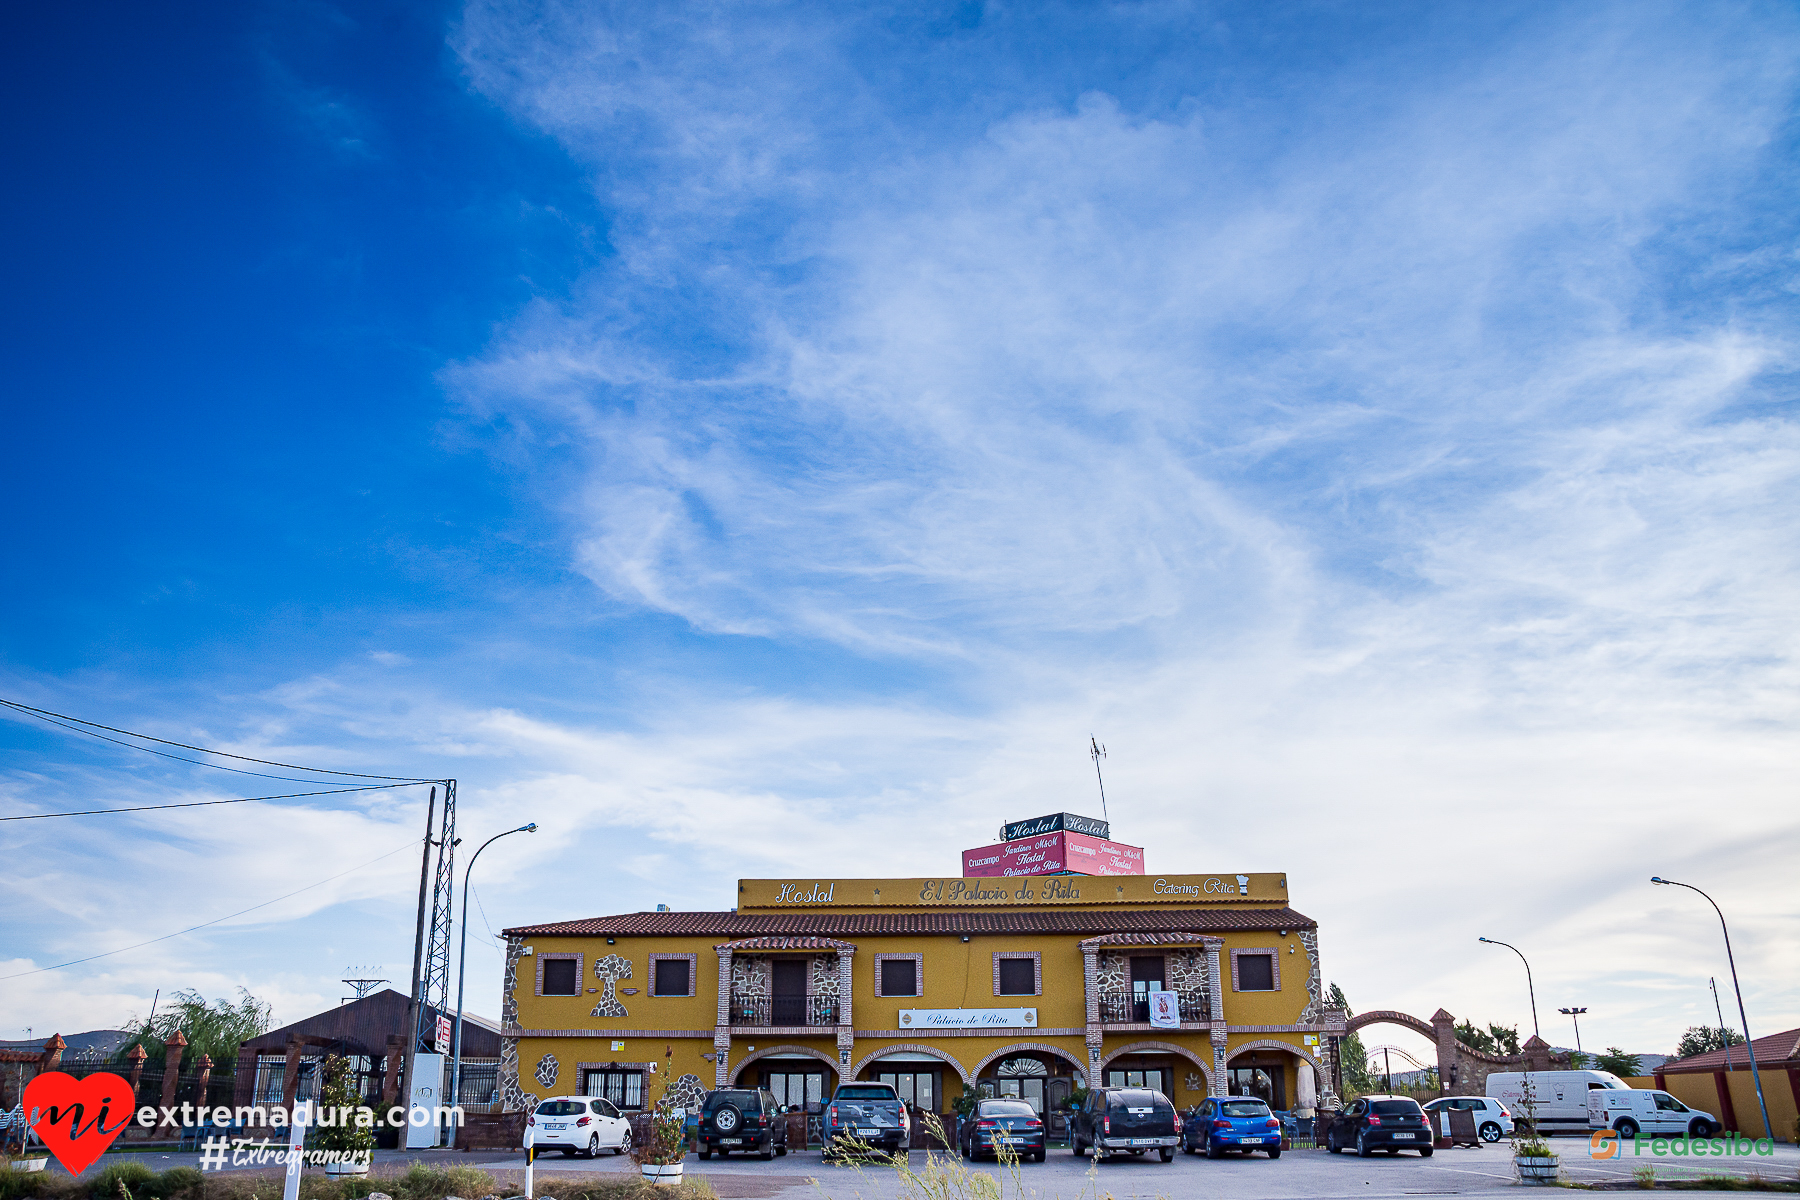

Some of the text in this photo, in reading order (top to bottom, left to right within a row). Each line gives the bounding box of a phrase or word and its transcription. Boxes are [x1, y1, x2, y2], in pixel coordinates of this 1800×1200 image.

[1008, 816, 1058, 839] Hostal
[1066, 817, 1107, 835] Hostal
[1003, 845, 1031, 858] Jardines
[1069, 842, 1096, 856] Cruzcampo
[968, 856, 1000, 867] Cruzcampo
[1016, 851, 1046, 865] Hostal
[1109, 856, 1132, 869] Hostal
[1002, 867, 1031, 877] Palacio
[1031, 864, 1041, 873] de
[1042, 860, 1061, 871] Rita
[775, 882, 834, 903] Hostal
[919, 879, 1080, 901] El Palacio de Rita
[1153, 878, 1234, 898] Catering Rita
[967, 1015, 978, 1024] de
[982, 1013, 1008, 1024] Rita
